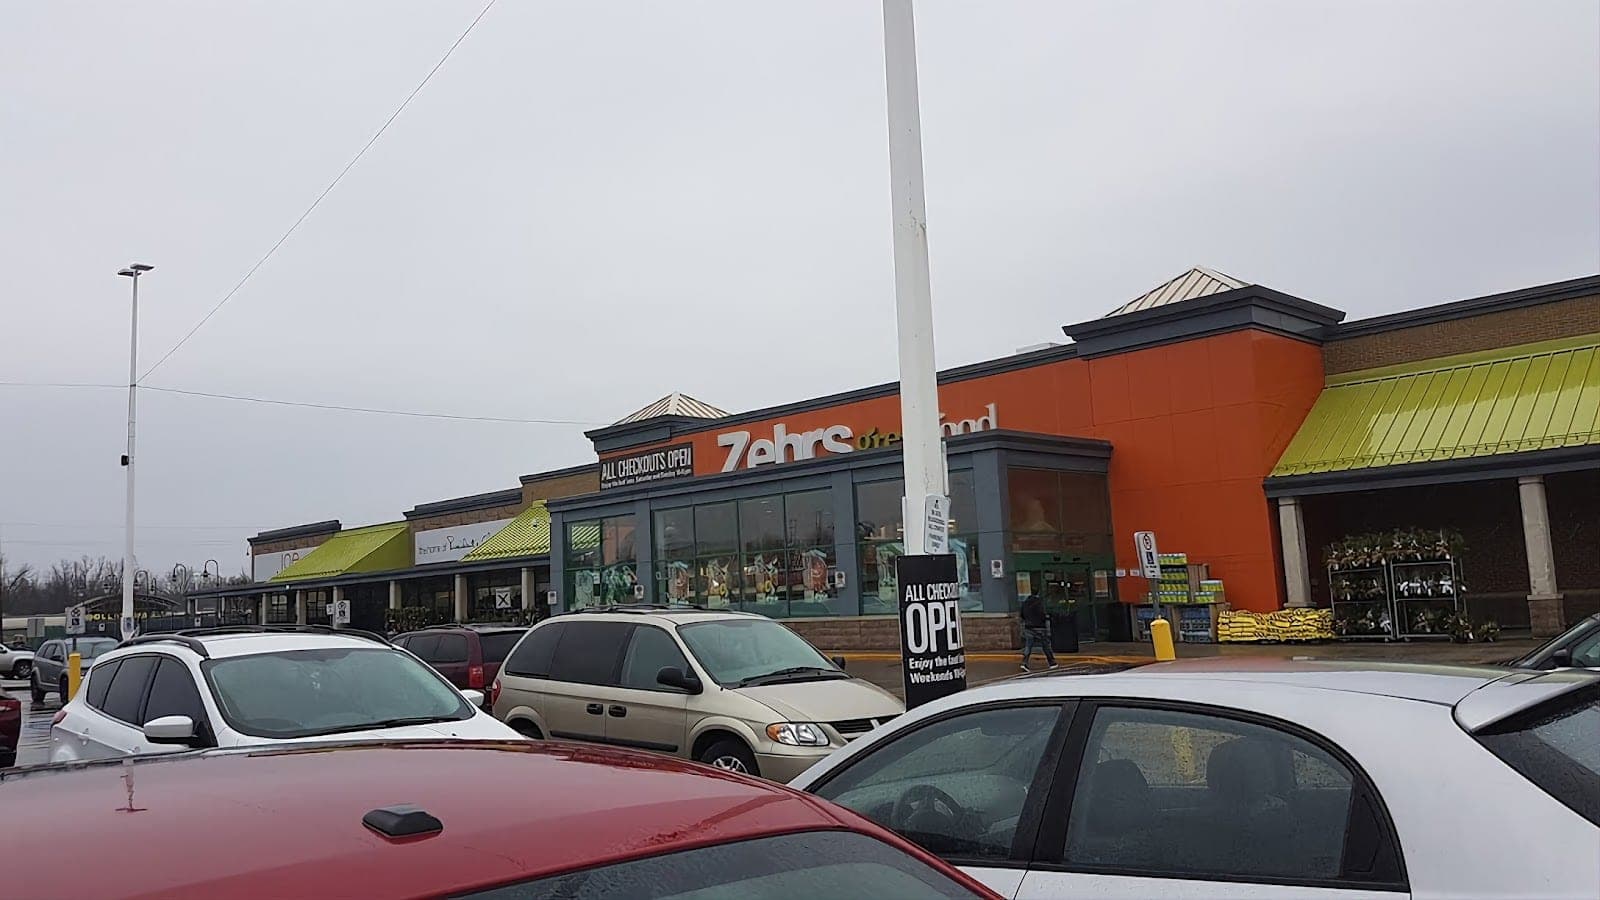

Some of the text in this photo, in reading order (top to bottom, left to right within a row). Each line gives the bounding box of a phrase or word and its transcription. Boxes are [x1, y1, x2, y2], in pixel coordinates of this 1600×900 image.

[718, 423, 854, 472] Zehrs
[601, 462, 616, 480] ALL
[618, 452, 666, 478] CHECKOUTS
[667, 447, 692, 469] OPEN
[905, 583, 925, 602] ALL
[909, 657, 934, 671] Enjoy
[935, 655, 948, 667] the
[910, 670, 953, 684] Weekends
